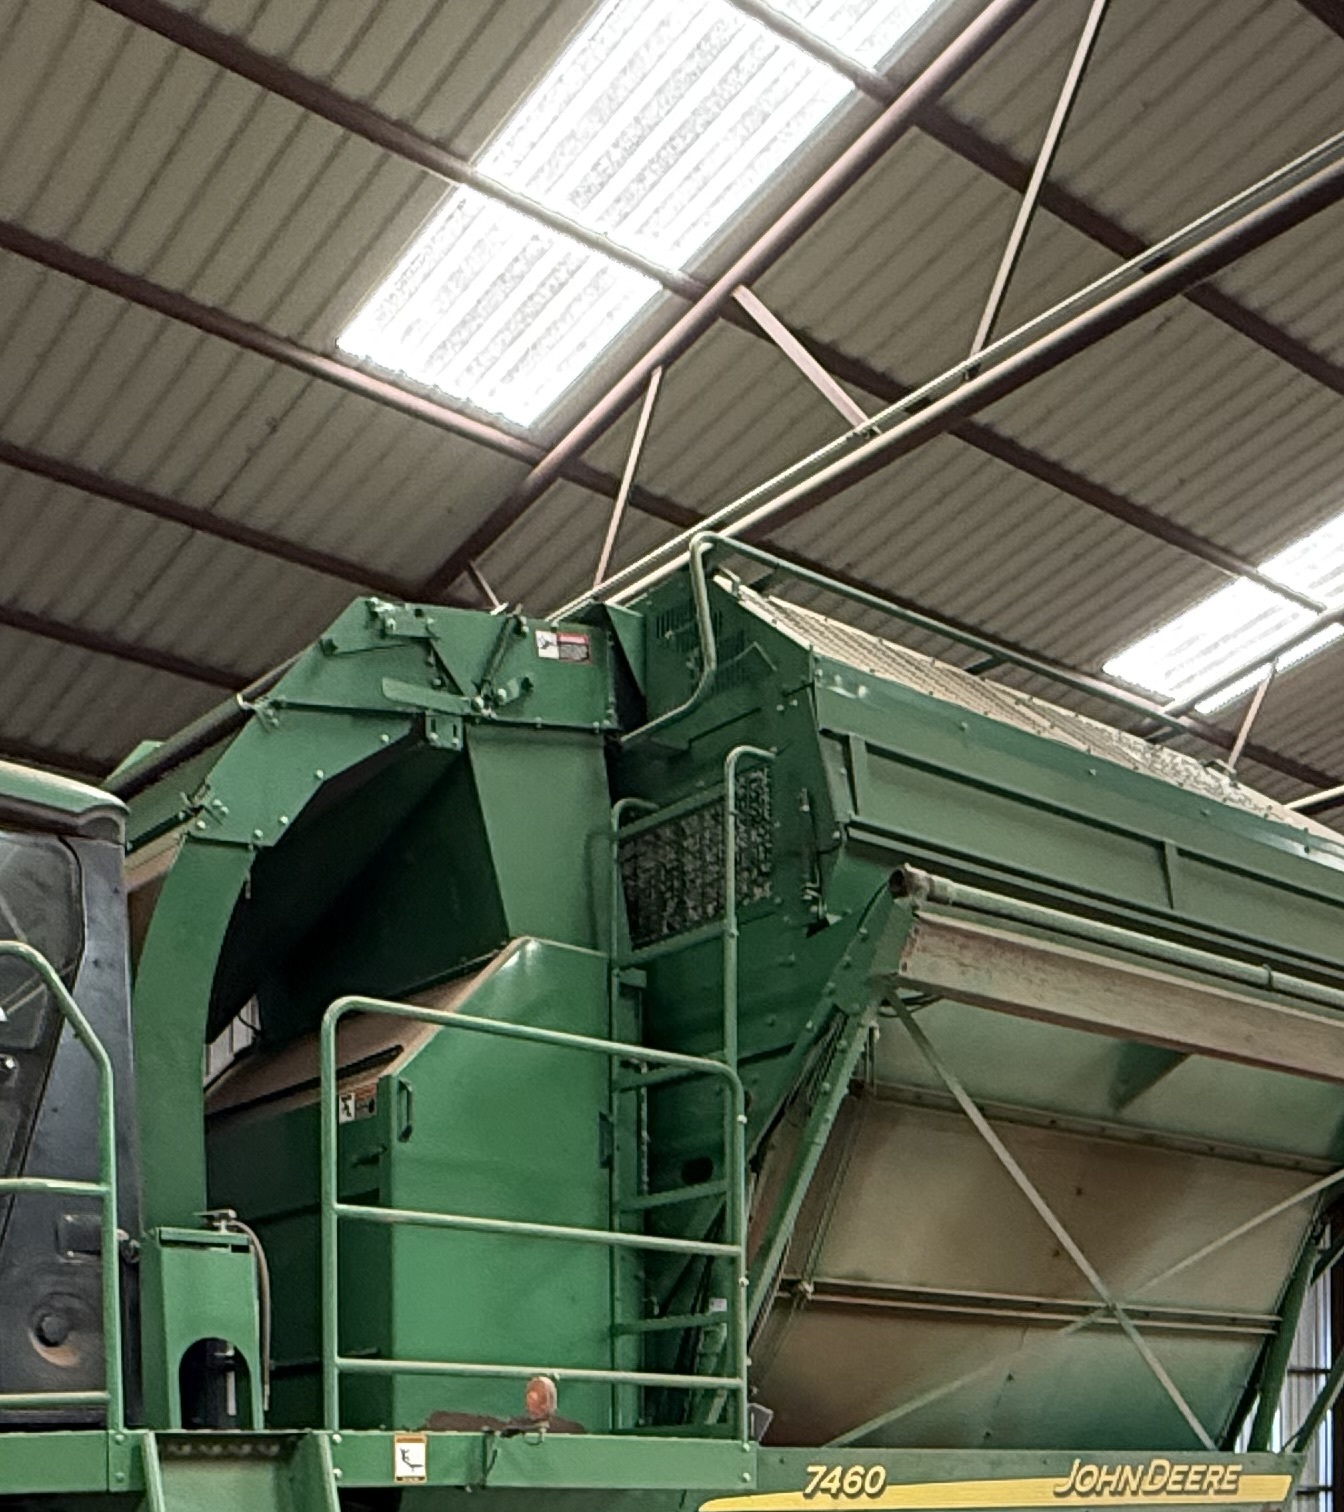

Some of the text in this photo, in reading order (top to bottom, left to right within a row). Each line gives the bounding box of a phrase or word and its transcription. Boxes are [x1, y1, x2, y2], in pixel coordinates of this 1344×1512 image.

[804, 1464, 887, 1497] 7460
[1054, 1457, 1244, 1496] JOHN DEERE
